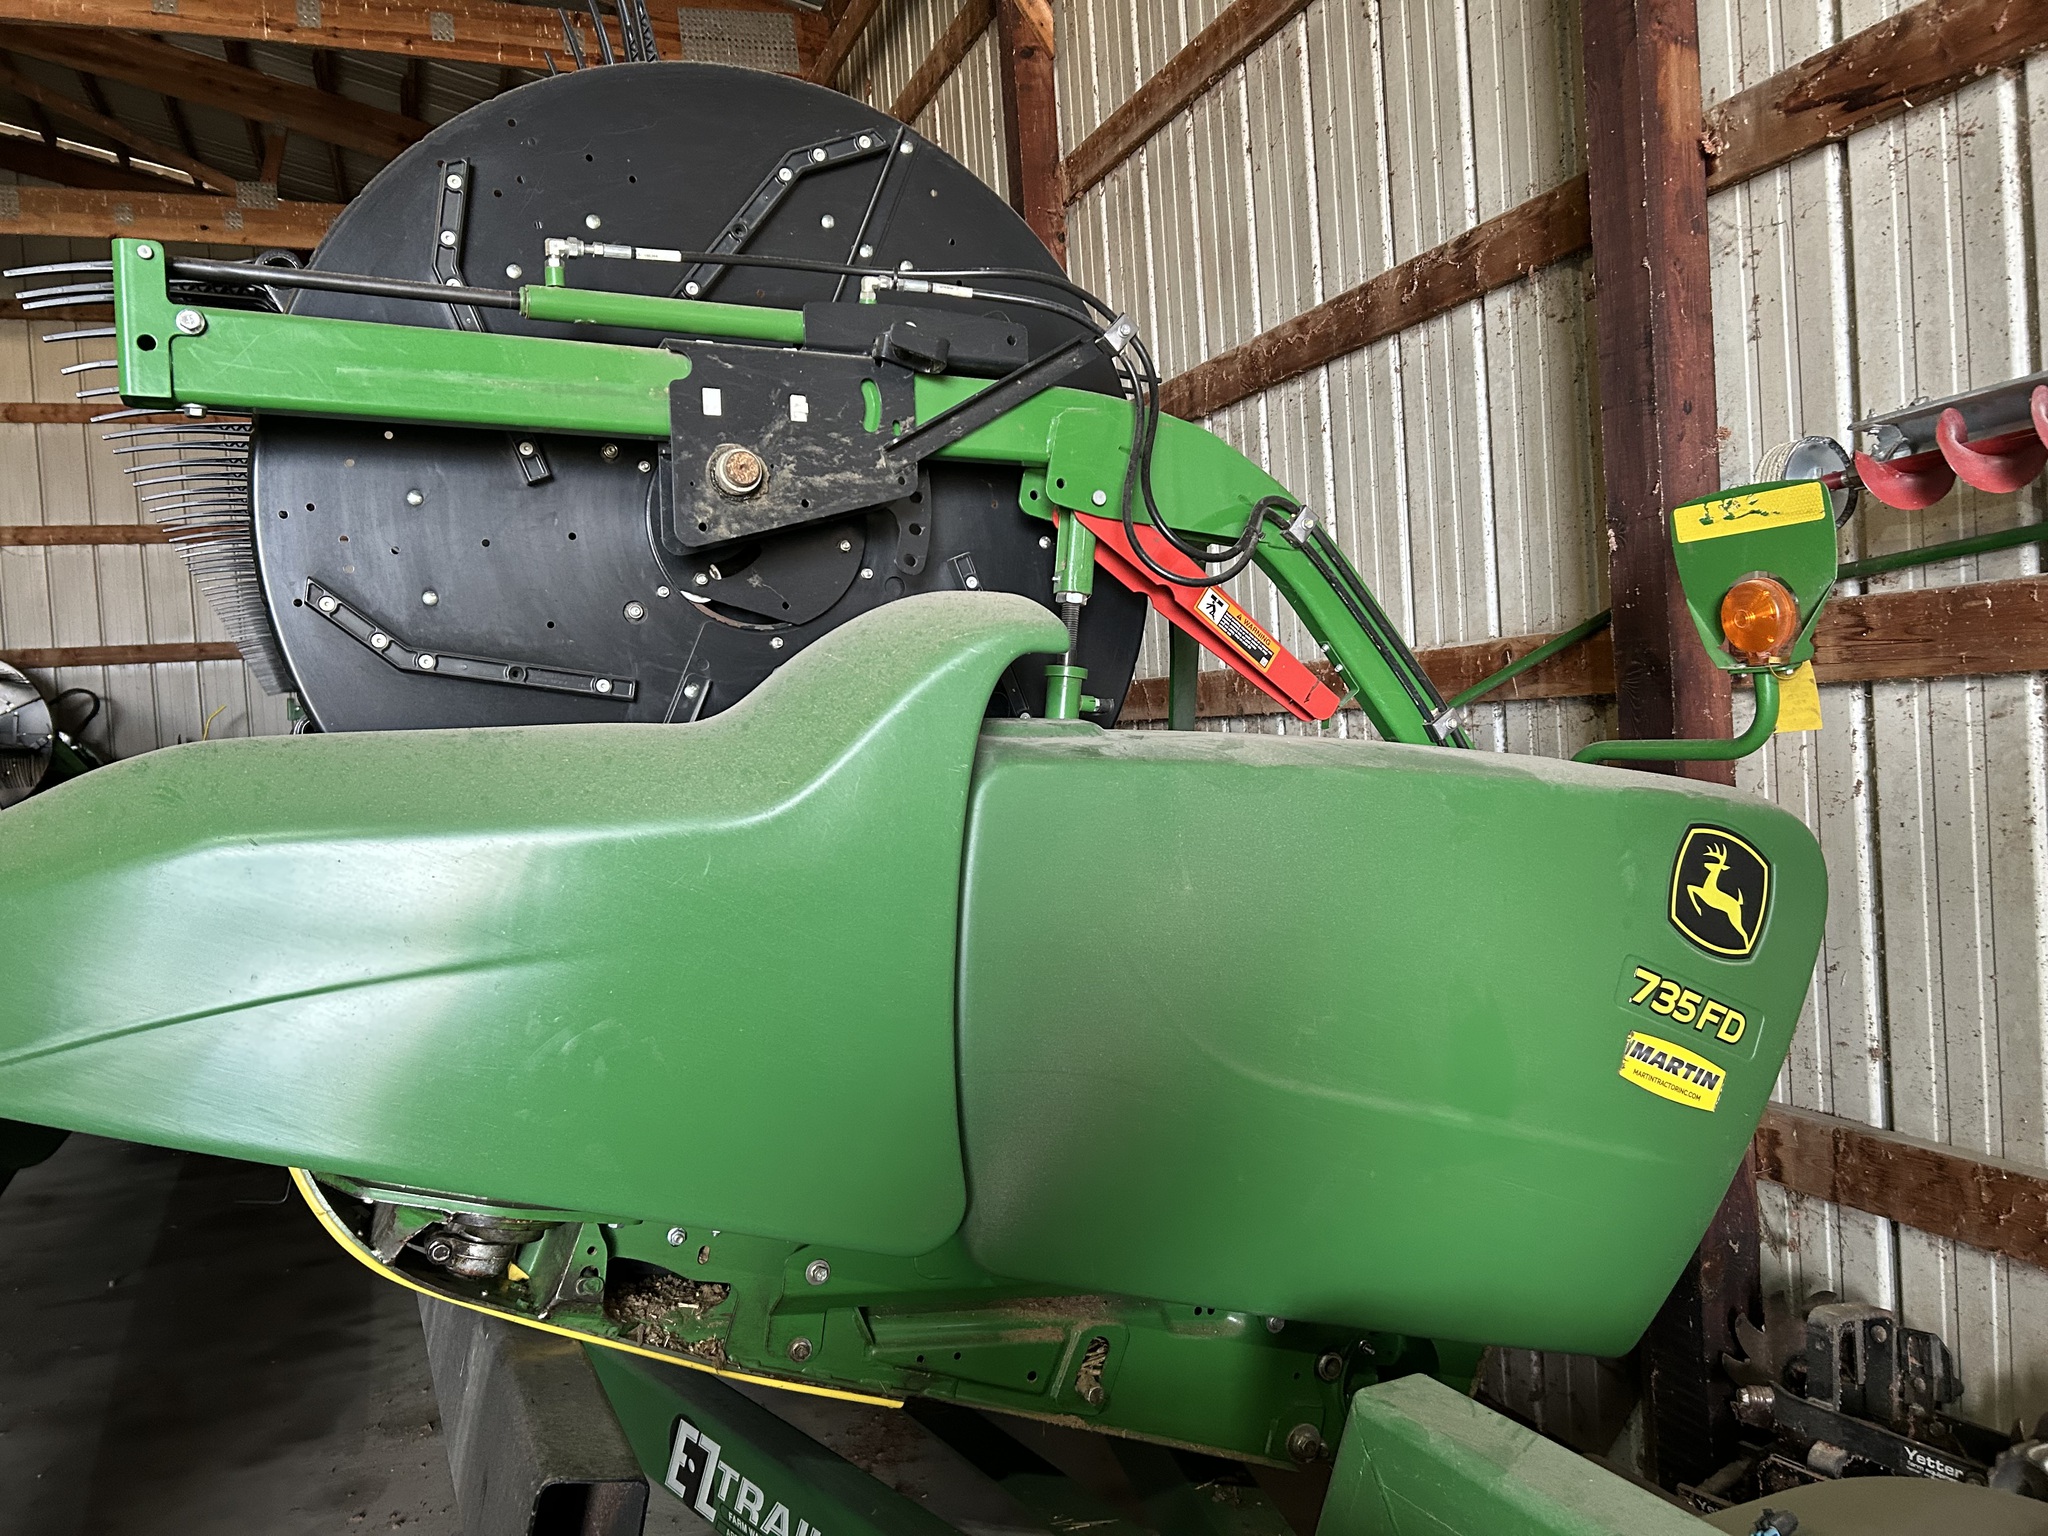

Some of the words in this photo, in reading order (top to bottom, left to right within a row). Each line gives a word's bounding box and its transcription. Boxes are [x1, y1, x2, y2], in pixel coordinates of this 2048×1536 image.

[1243, 618, 1272, 647] WARNING
[1628, 965, 1748, 1046] 735FD
[1629, 1041, 1721, 1091] MARTIN
[1632, 1068, 1702, 1102] MARTINTRACTORINC.COM
[1903, 1445, 1965, 1479] Yetter
[716, 1459, 823, 1536] TRAI
